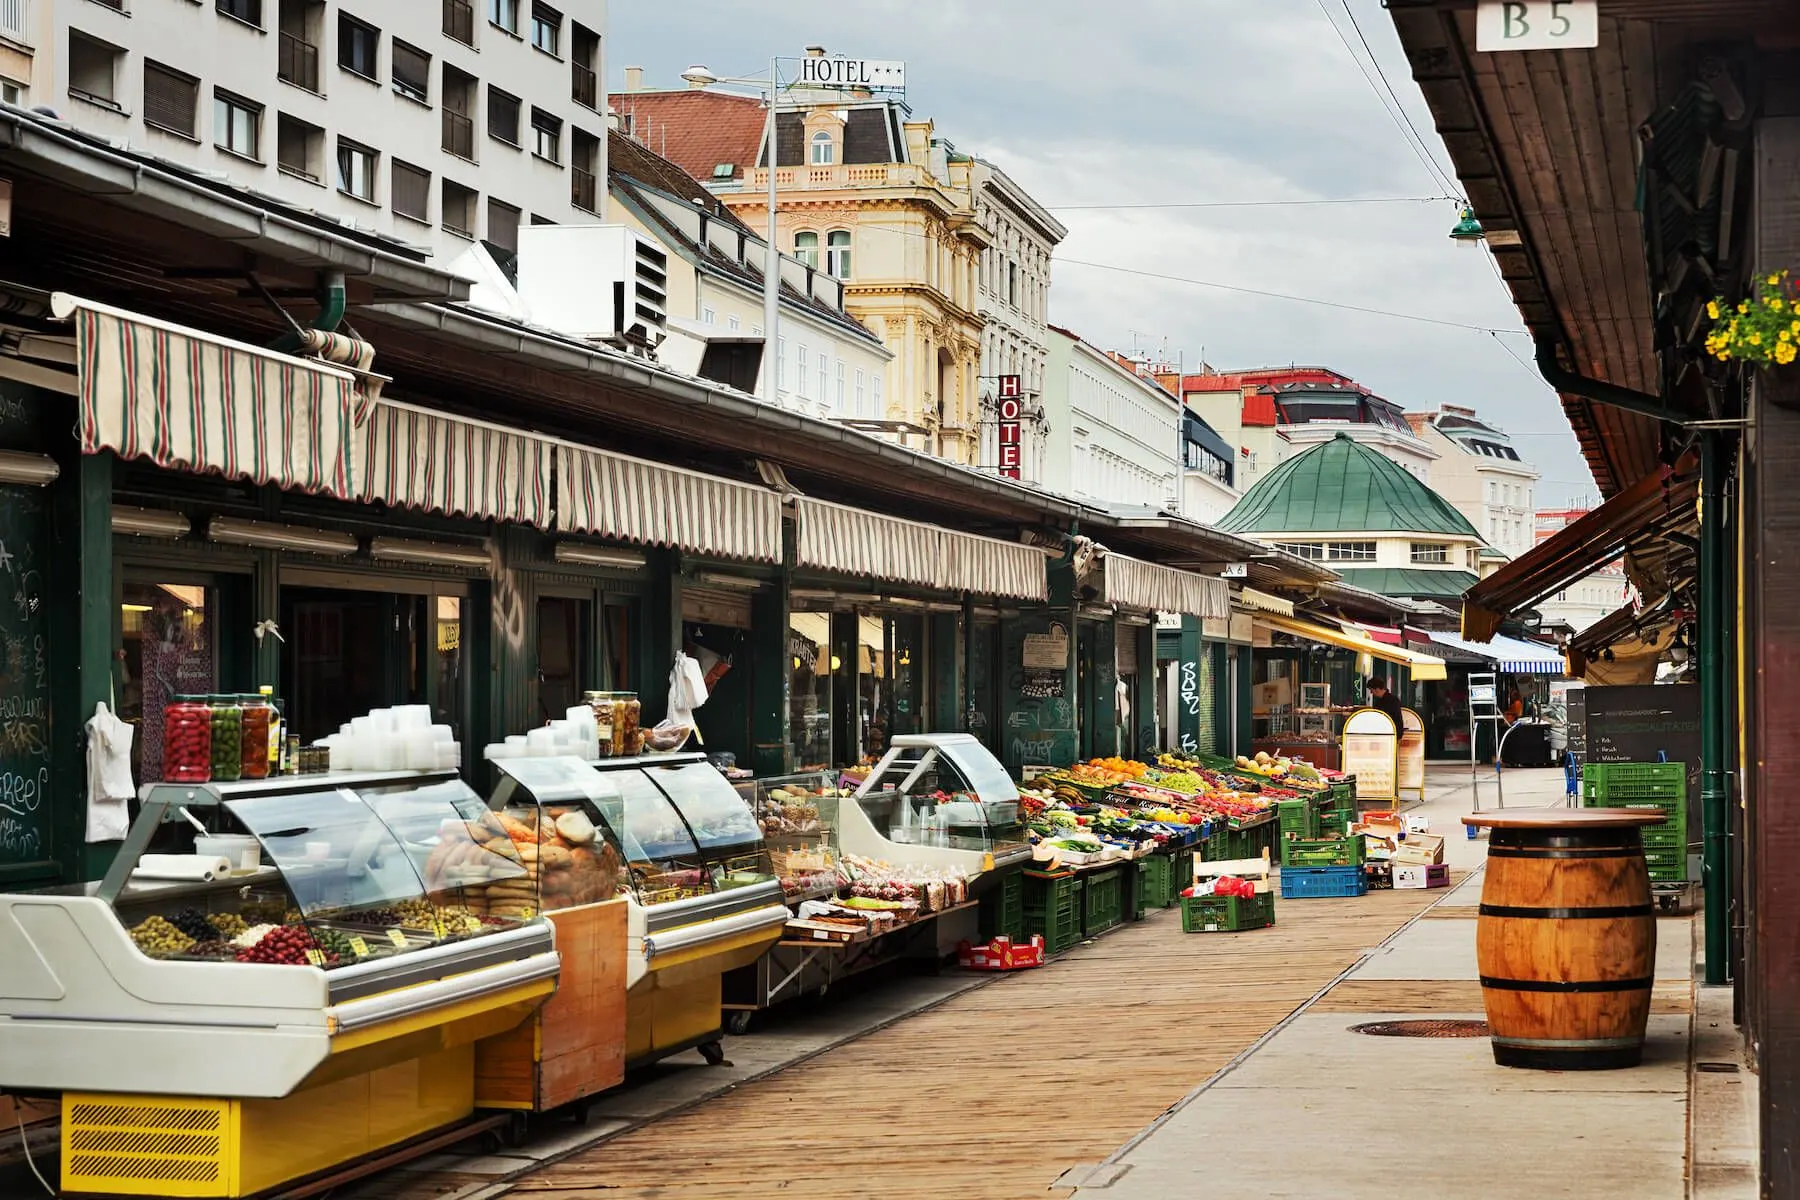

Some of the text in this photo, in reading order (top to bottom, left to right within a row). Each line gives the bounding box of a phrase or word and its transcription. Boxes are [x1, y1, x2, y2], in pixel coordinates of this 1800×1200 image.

[1502, 0, 1573, 39] B 5
[803, 59, 871, 83] HOTEL
[1225, 565, 1243, 576] A 6
[1105, 793, 1130, 804] Royal
